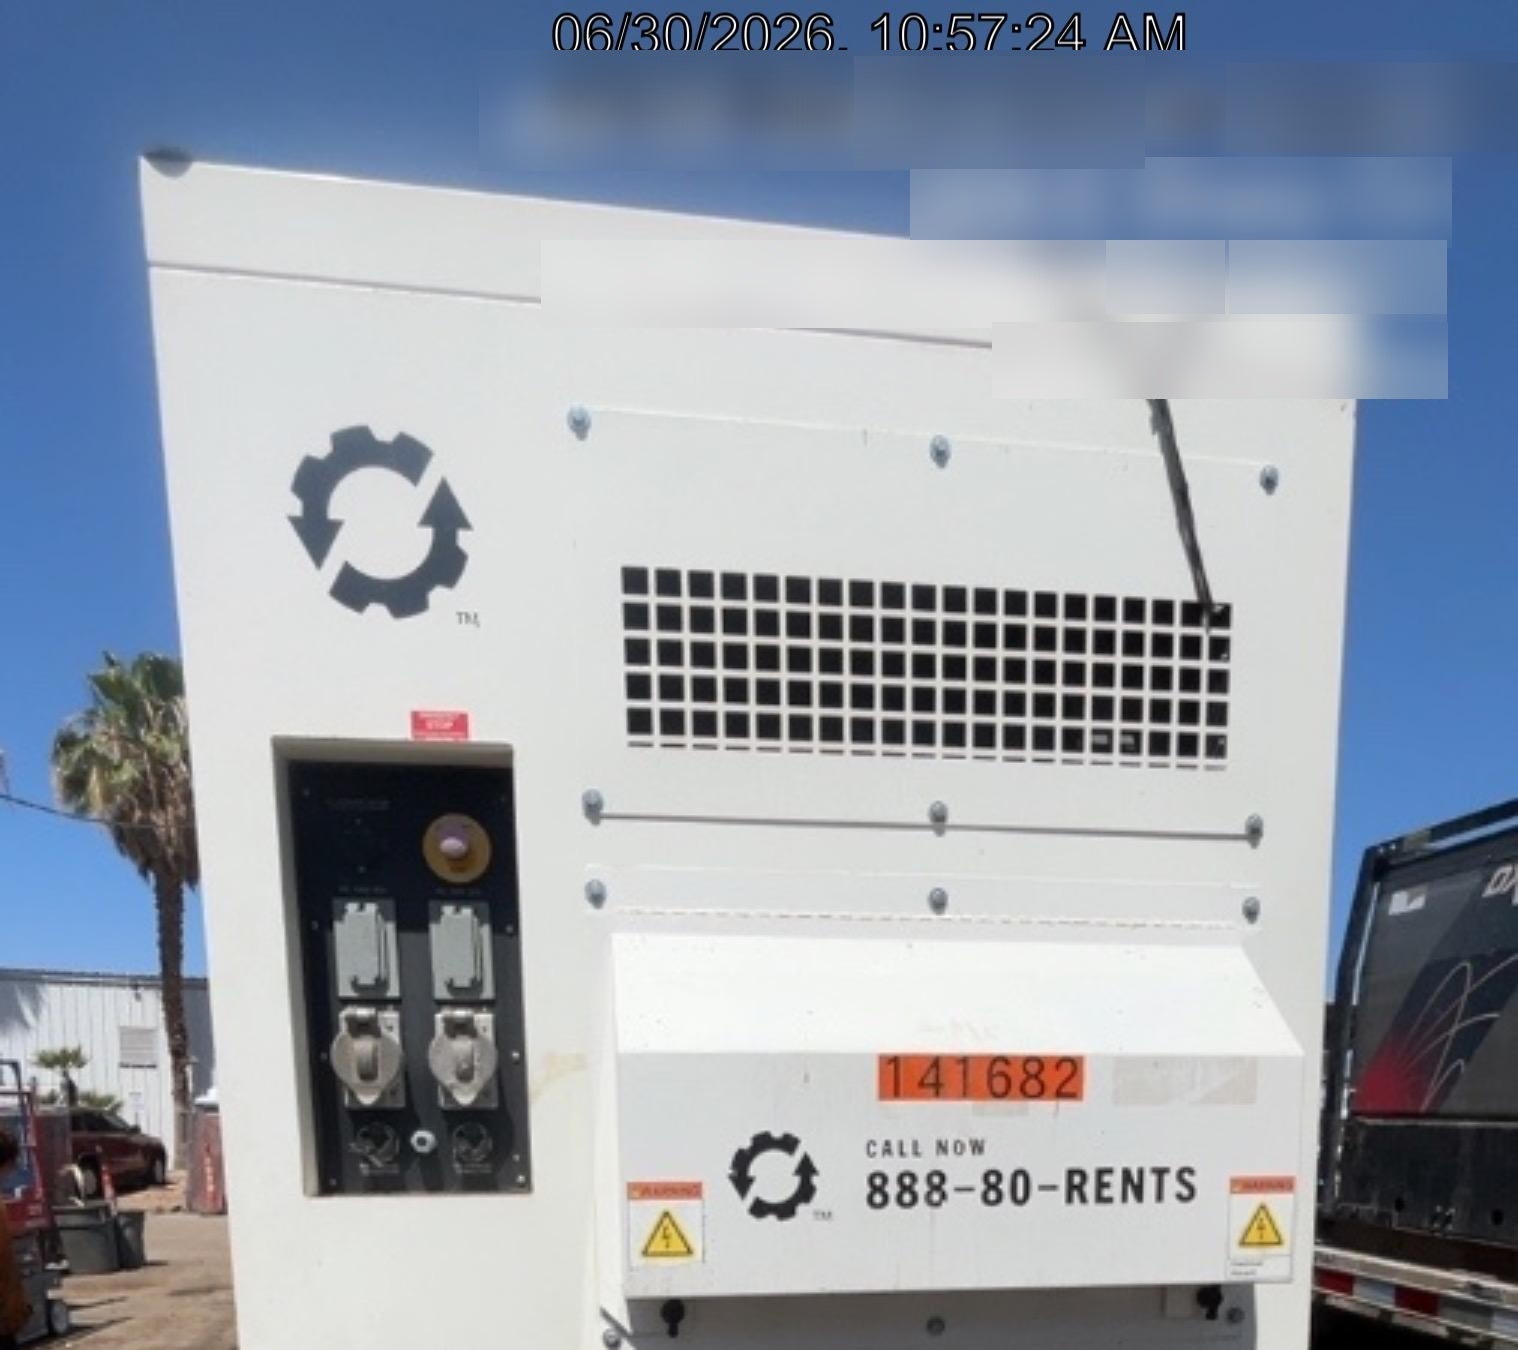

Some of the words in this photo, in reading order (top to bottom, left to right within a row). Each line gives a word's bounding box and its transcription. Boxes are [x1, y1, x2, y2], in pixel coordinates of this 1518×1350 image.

[886, 1055, 1078, 1099] 141682
[865, 1139, 922, 1159] CALL
[935, 1138, 987, 1157] NOW
[865, 1165, 1198, 1210] 888-80-RENTS
